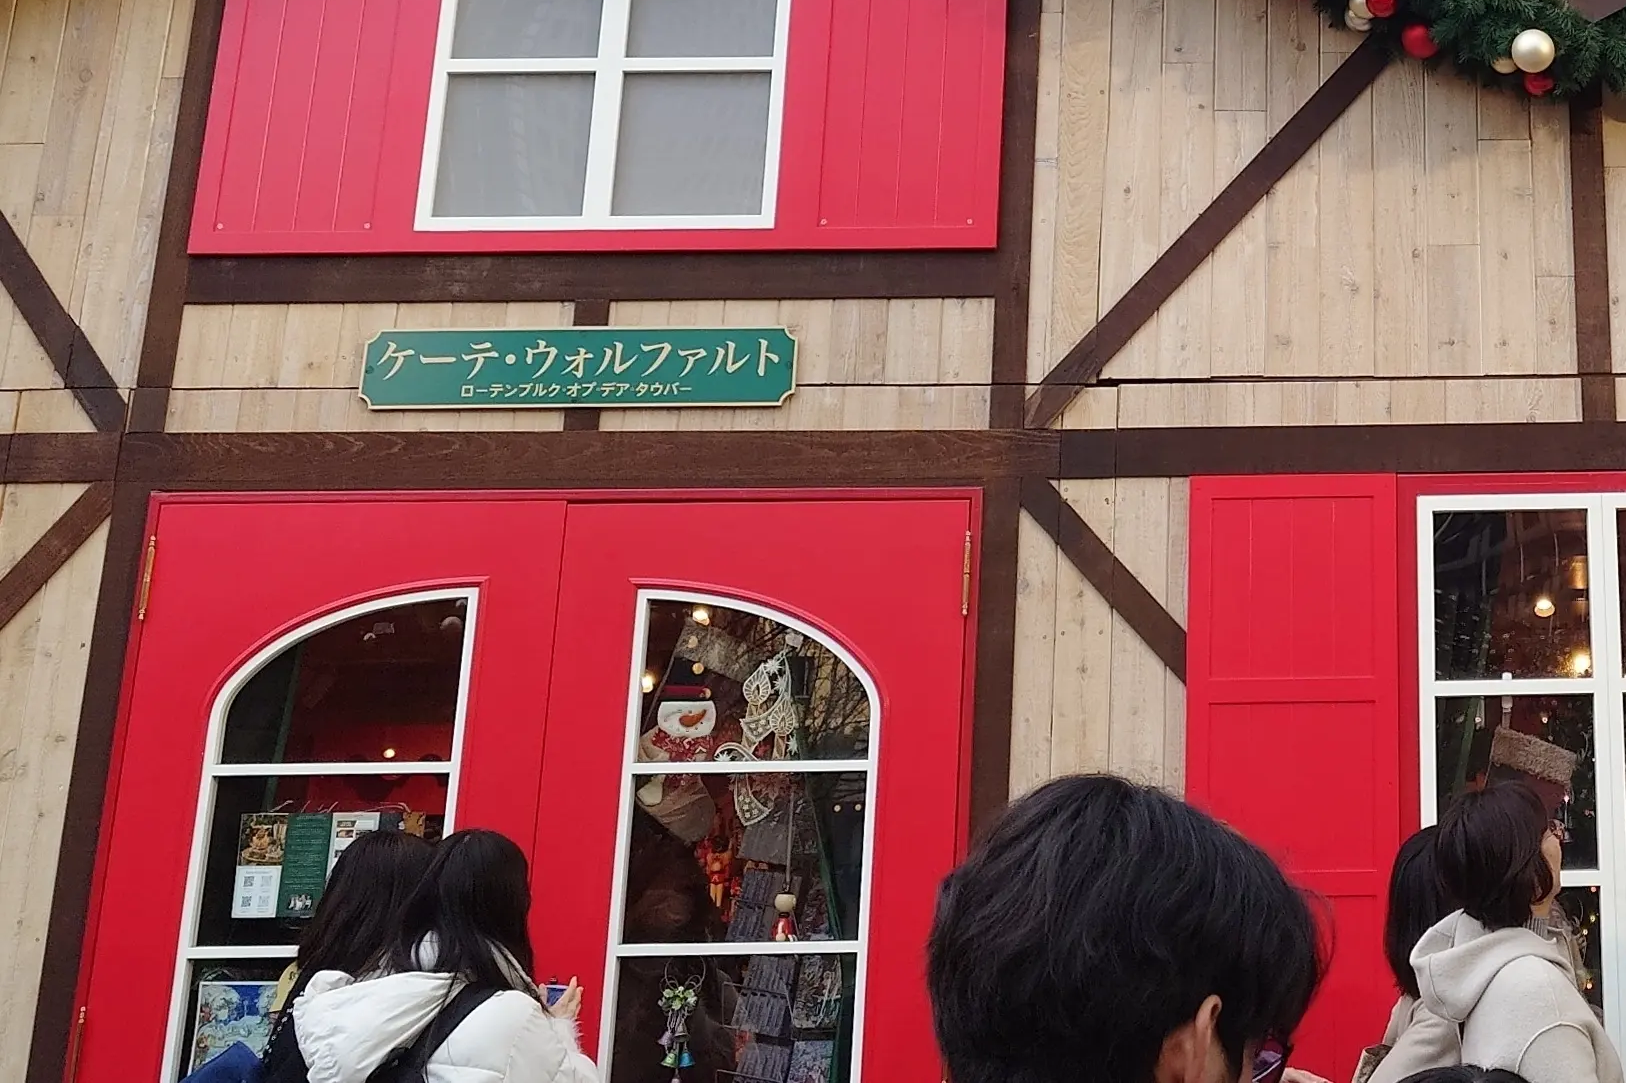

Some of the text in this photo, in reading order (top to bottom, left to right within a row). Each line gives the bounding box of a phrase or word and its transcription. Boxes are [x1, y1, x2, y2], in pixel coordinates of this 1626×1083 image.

[376, 339, 780, 380] ケーテ・ウォルファルト
